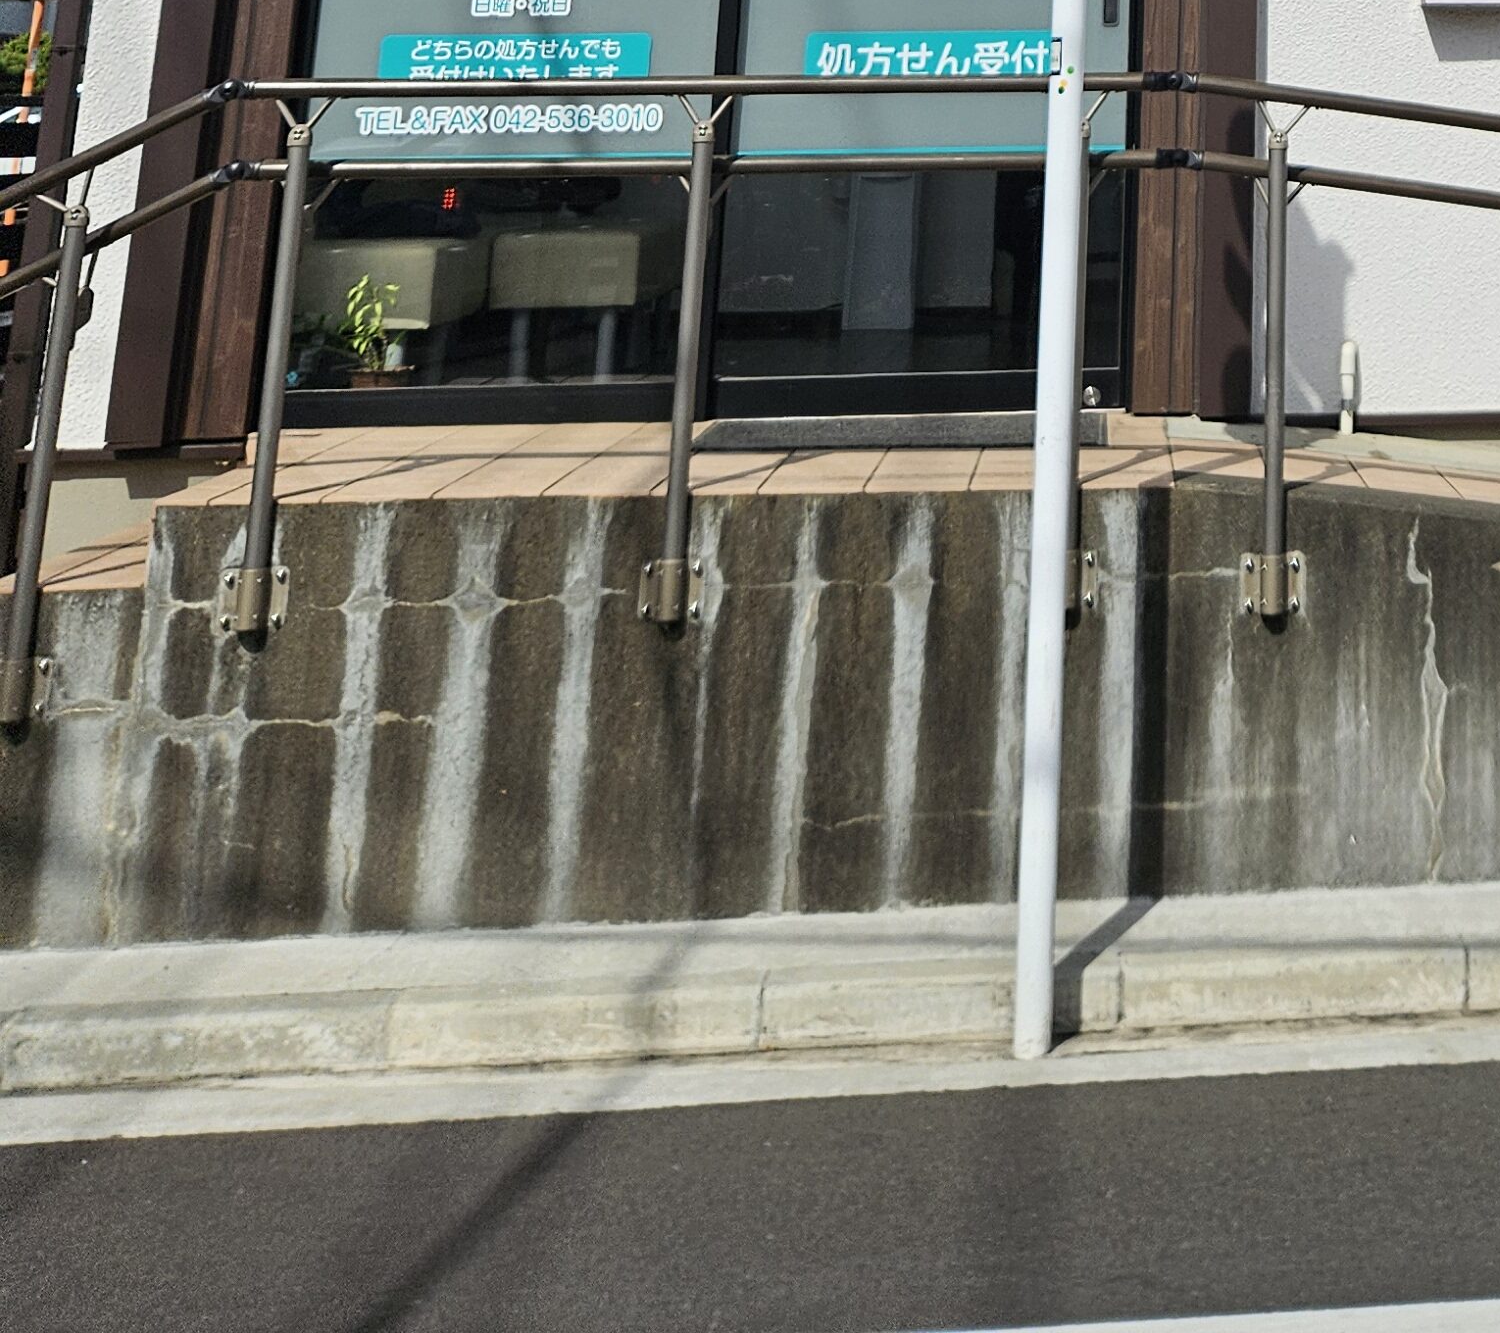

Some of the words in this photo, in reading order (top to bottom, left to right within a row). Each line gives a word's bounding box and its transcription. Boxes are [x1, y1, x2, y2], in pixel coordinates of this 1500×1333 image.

[410, 39, 622, 61] どちらの処方せんでも
[817, 40, 1050, 76] 処方せん受付
[356, 106, 488, 135] TEL&FAX
[490, 103, 664, 133] 042-536-3010
